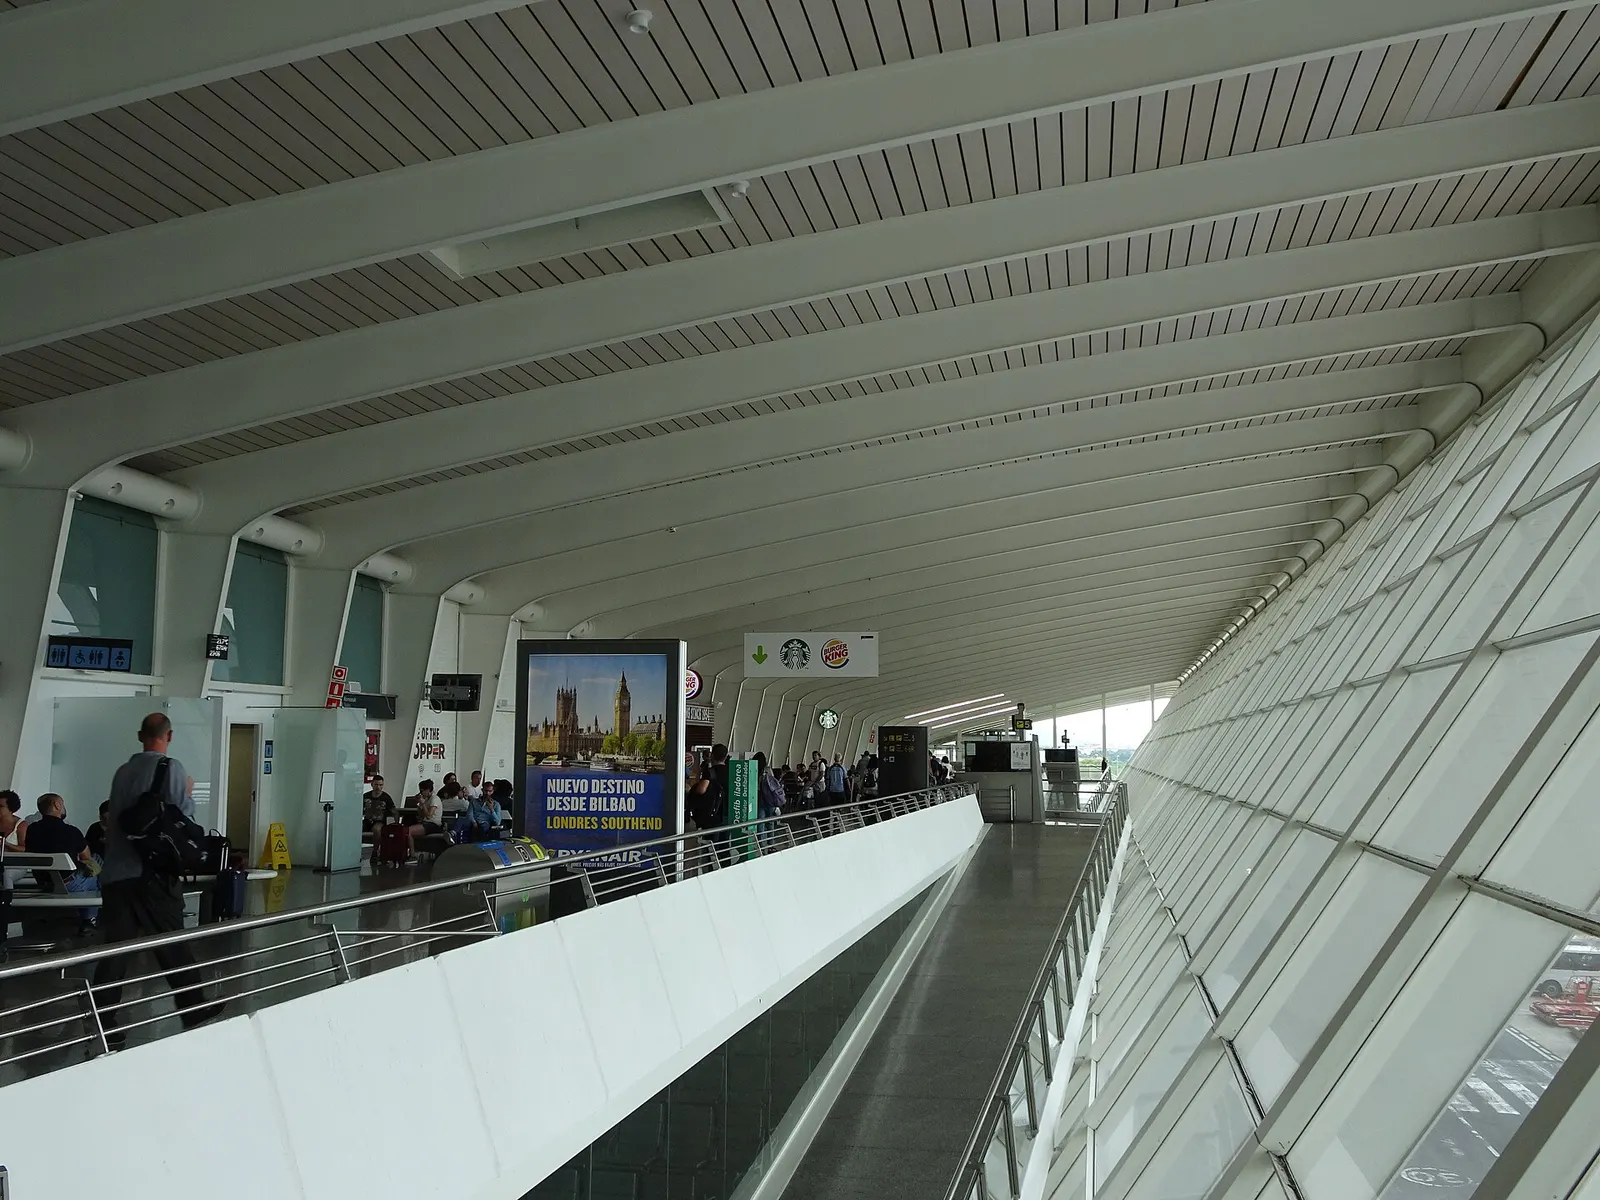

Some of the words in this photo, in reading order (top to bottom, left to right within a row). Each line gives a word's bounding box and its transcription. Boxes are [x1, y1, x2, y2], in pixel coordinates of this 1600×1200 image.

[823, 642, 848, 655] BURGER
[824, 649, 849, 663] KING
[1024, 720, 1030, 729] 5
[421, 727, 429, 740] OF
[429, 727, 440, 740] THE
[546, 778, 588, 793] NUEVO
[591, 779, 645, 794] DESTINO
[546, 796, 587, 811] DESDE
[589, 796, 636, 812] BILBAO
[546, 815, 599, 830] LONDRES
[601, 816, 663, 830] SOUTHEND
